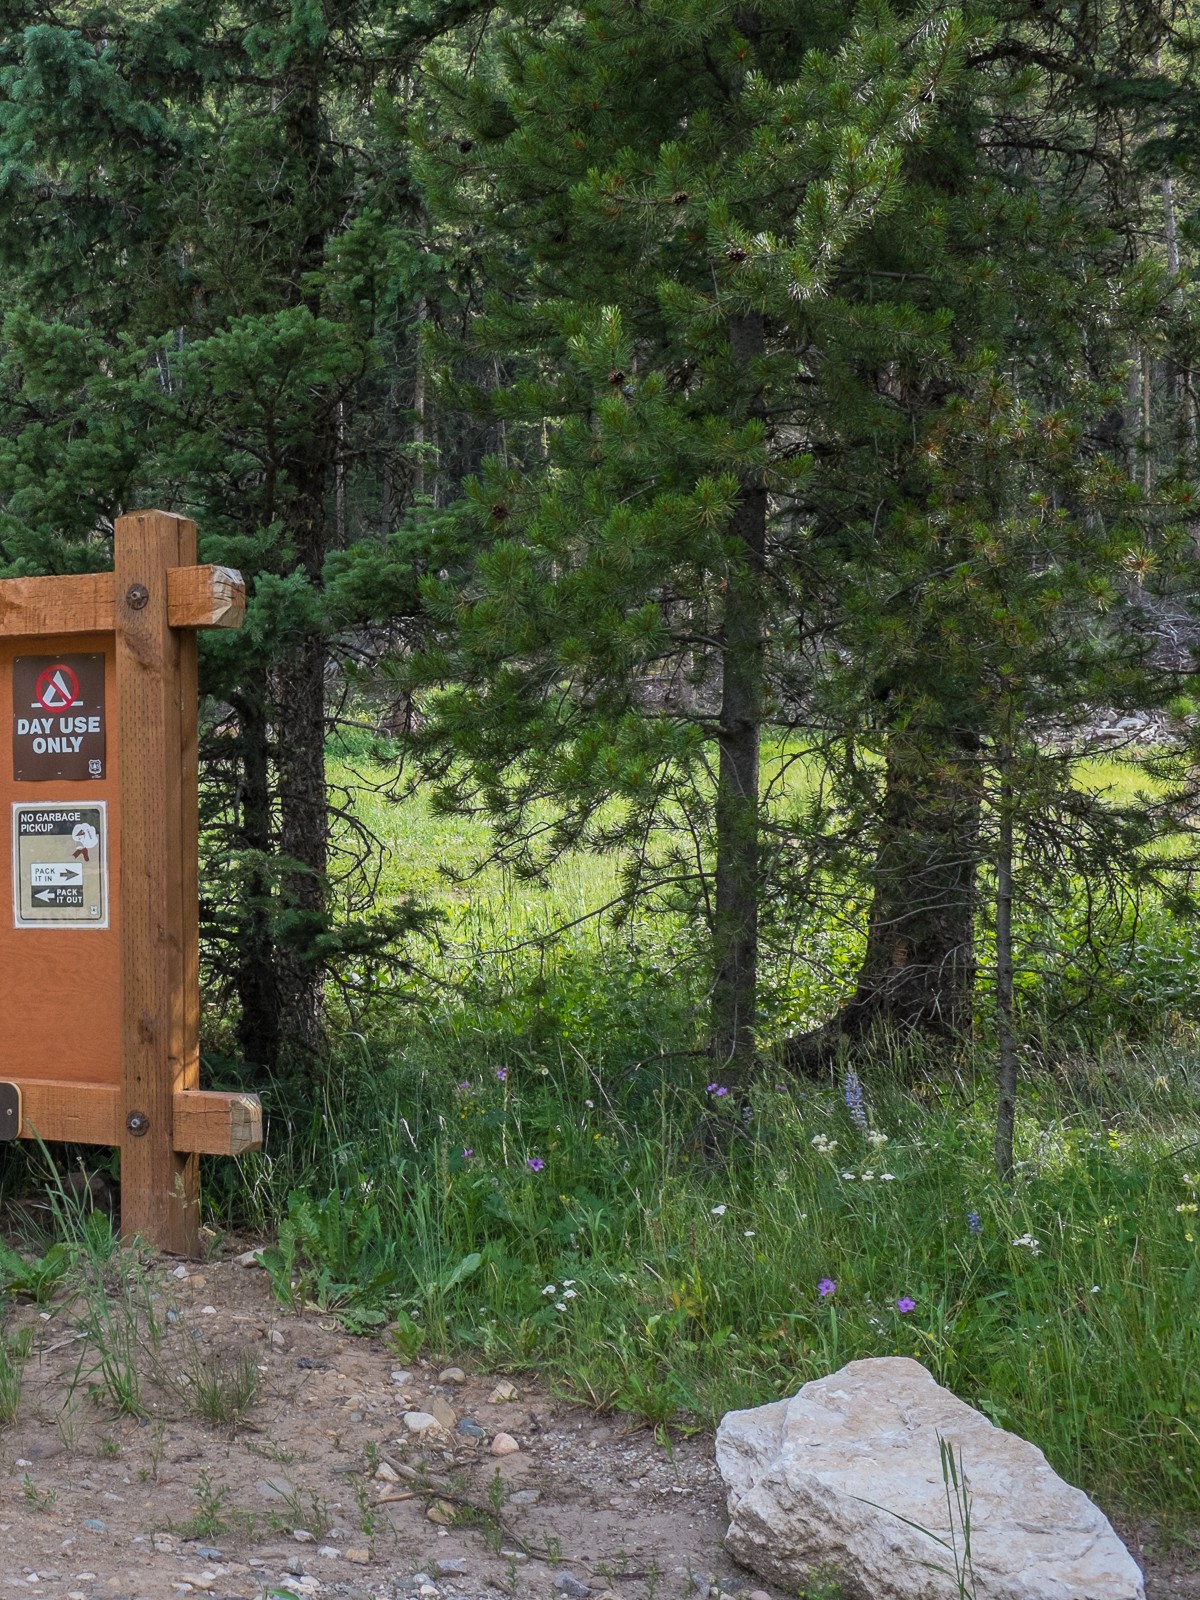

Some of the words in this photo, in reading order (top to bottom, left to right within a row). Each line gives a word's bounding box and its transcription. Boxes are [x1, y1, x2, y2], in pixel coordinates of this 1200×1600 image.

[17, 718, 54, 735] DAY
[59, 716, 100, 734] USE
[32, 736, 84, 754] ONLY
[20, 813, 34, 822] NO
[35, 812, 81, 822] GARBAGE
[20, 823, 53, 833] PICKUP
[34, 867, 56, 875] PACK
[56, 888, 78, 896] PACK
[56, 896, 63, 904] IT
